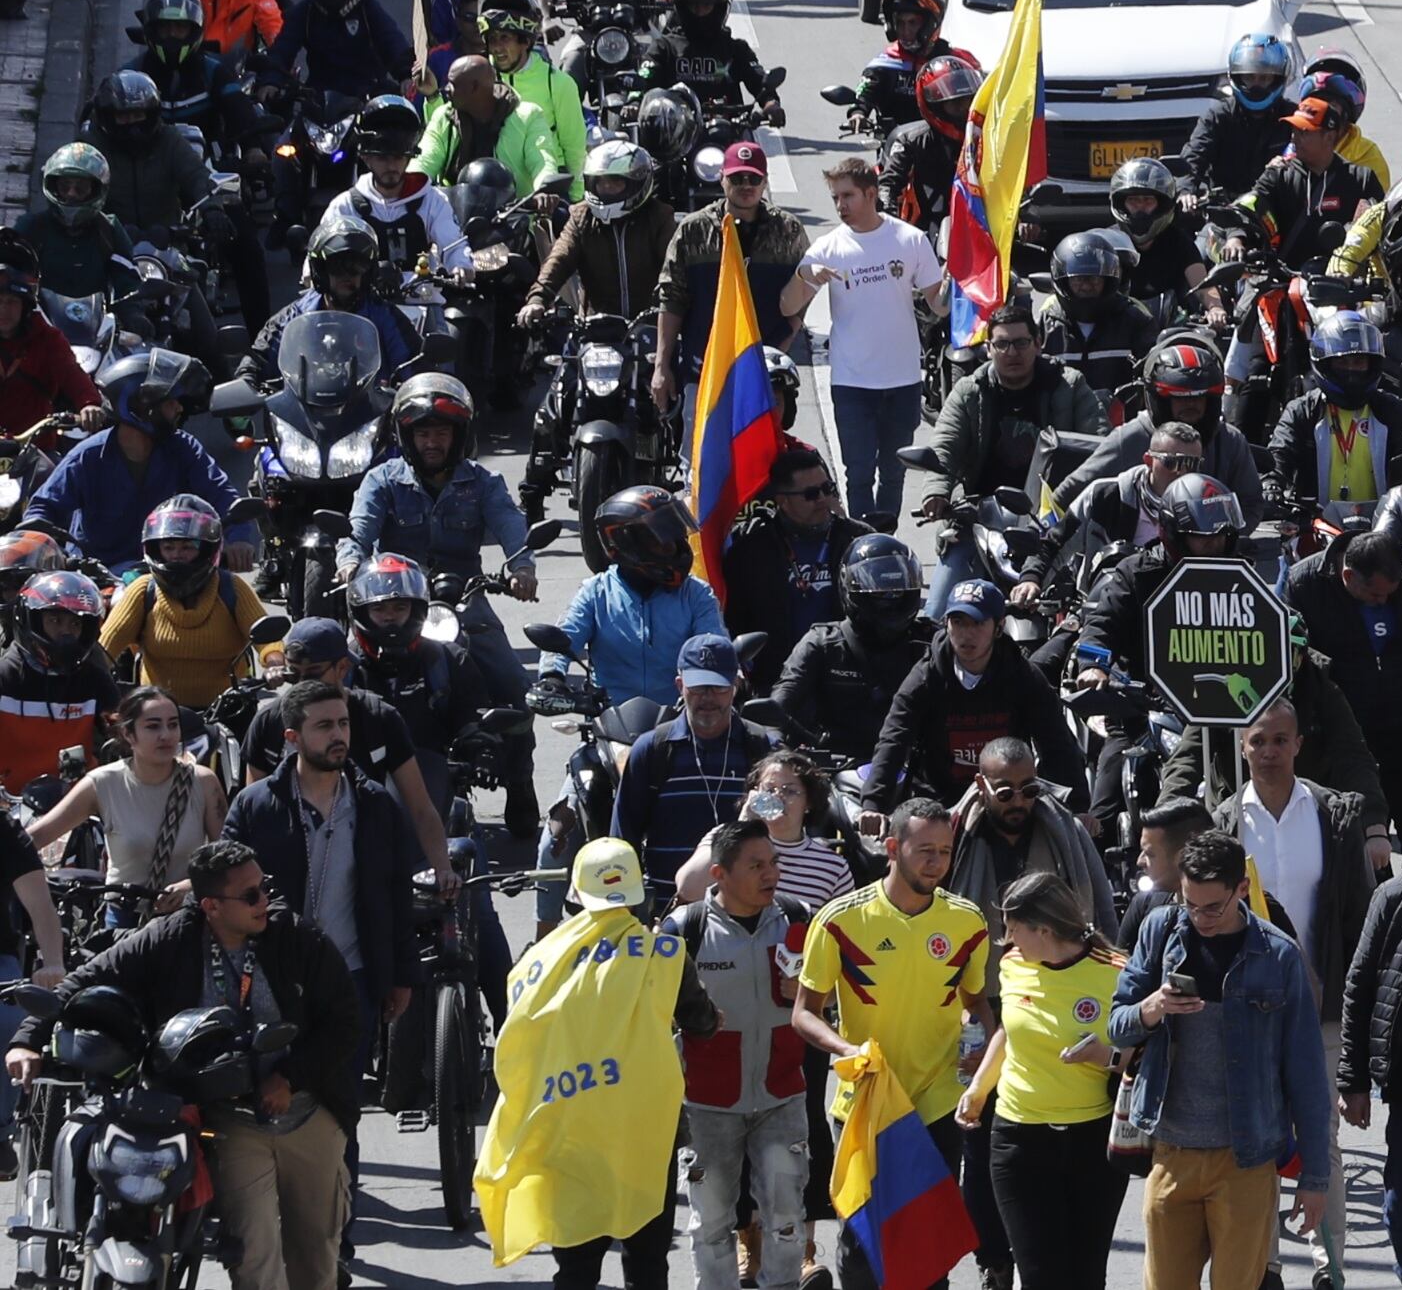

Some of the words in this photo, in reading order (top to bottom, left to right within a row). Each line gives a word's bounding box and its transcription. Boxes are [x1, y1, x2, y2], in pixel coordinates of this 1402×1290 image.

[675, 57, 718, 76] GAD
[851, 263, 886, 277] Libertad
[854, 279, 861, 287] y
[862, 273, 888, 284] Orden
[1342, 515, 1371, 524] HONDA
[954, 582, 984, 599] USA
[1175, 591, 1202, 627] NO
[1209, 583, 1255, 629] MÁS
[1374, 621, 1387, 637] S
[1168, 628, 1265, 666] AUMENTO
[697, 961, 737, 972] PRENSA
[542, 1058, 621, 1104] 2023
